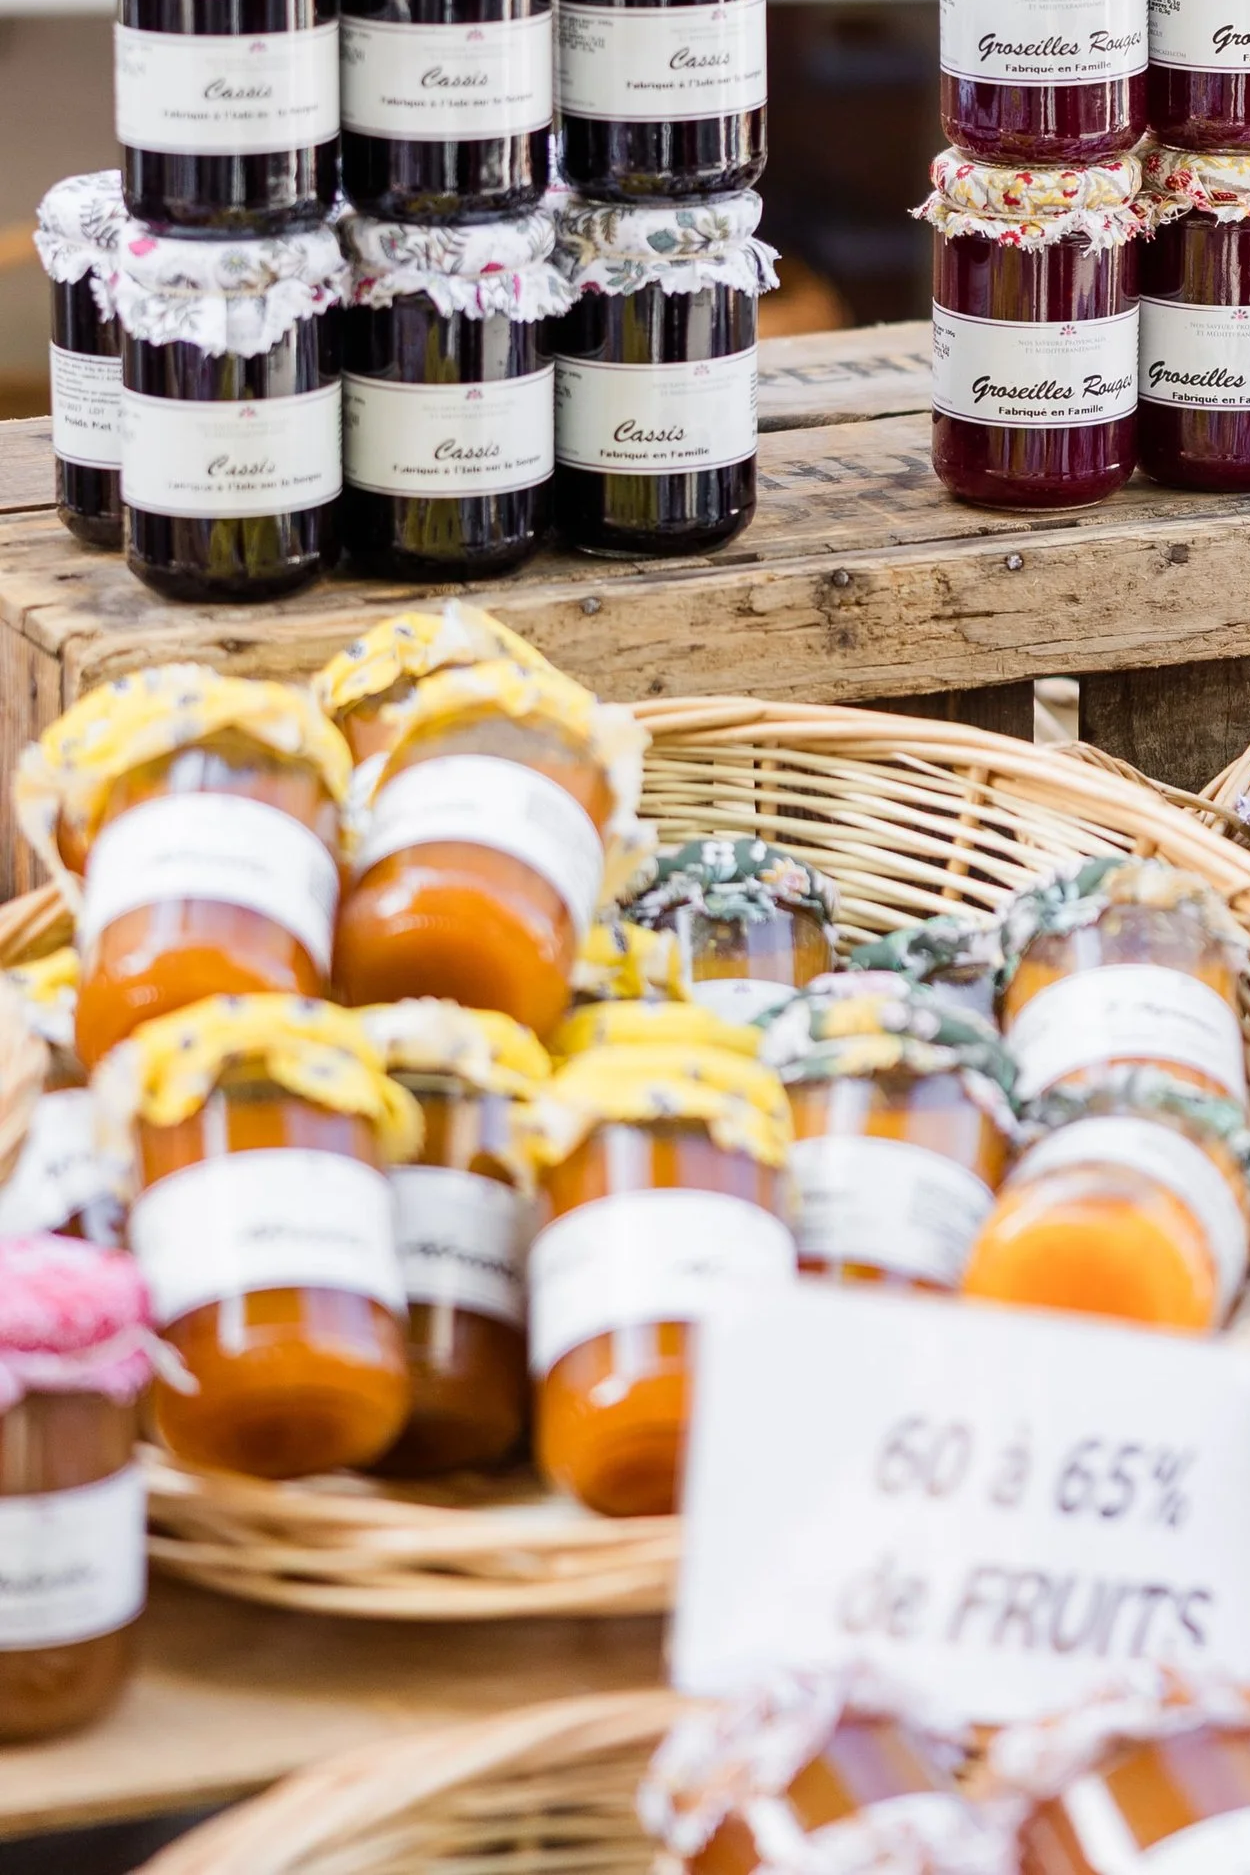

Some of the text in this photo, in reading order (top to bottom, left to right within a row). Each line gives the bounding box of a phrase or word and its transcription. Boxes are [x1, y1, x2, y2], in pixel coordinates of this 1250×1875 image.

[978, 33, 1081, 61] Groseilles
[1089, 30, 1142, 55] Rouges
[670, 46, 730, 70] Cassis
[1006, 62, 1111, 73] Fabriqué en Famille
[421, 66, 488, 88] Cassis
[204, 78, 272, 101] Cassis
[1149, 360, 1246, 387] Groseilles
[972, 374, 1132, 403] Groseilles Rouges
[1172, 391, 1218, 404] Fabriqué
[999, 405, 1103, 418] Fabriqué en Famille
[613, 419, 686, 443] Cassis
[434, 439, 501, 461] Cassis
[652, 451, 667, 459] en
[207, 455, 276, 479] Cassis
[875, 1415, 974, 1497] 60
[1055, 1435, 1198, 1531] 65%
[835, 1551, 1213, 1660] de FRUITS
